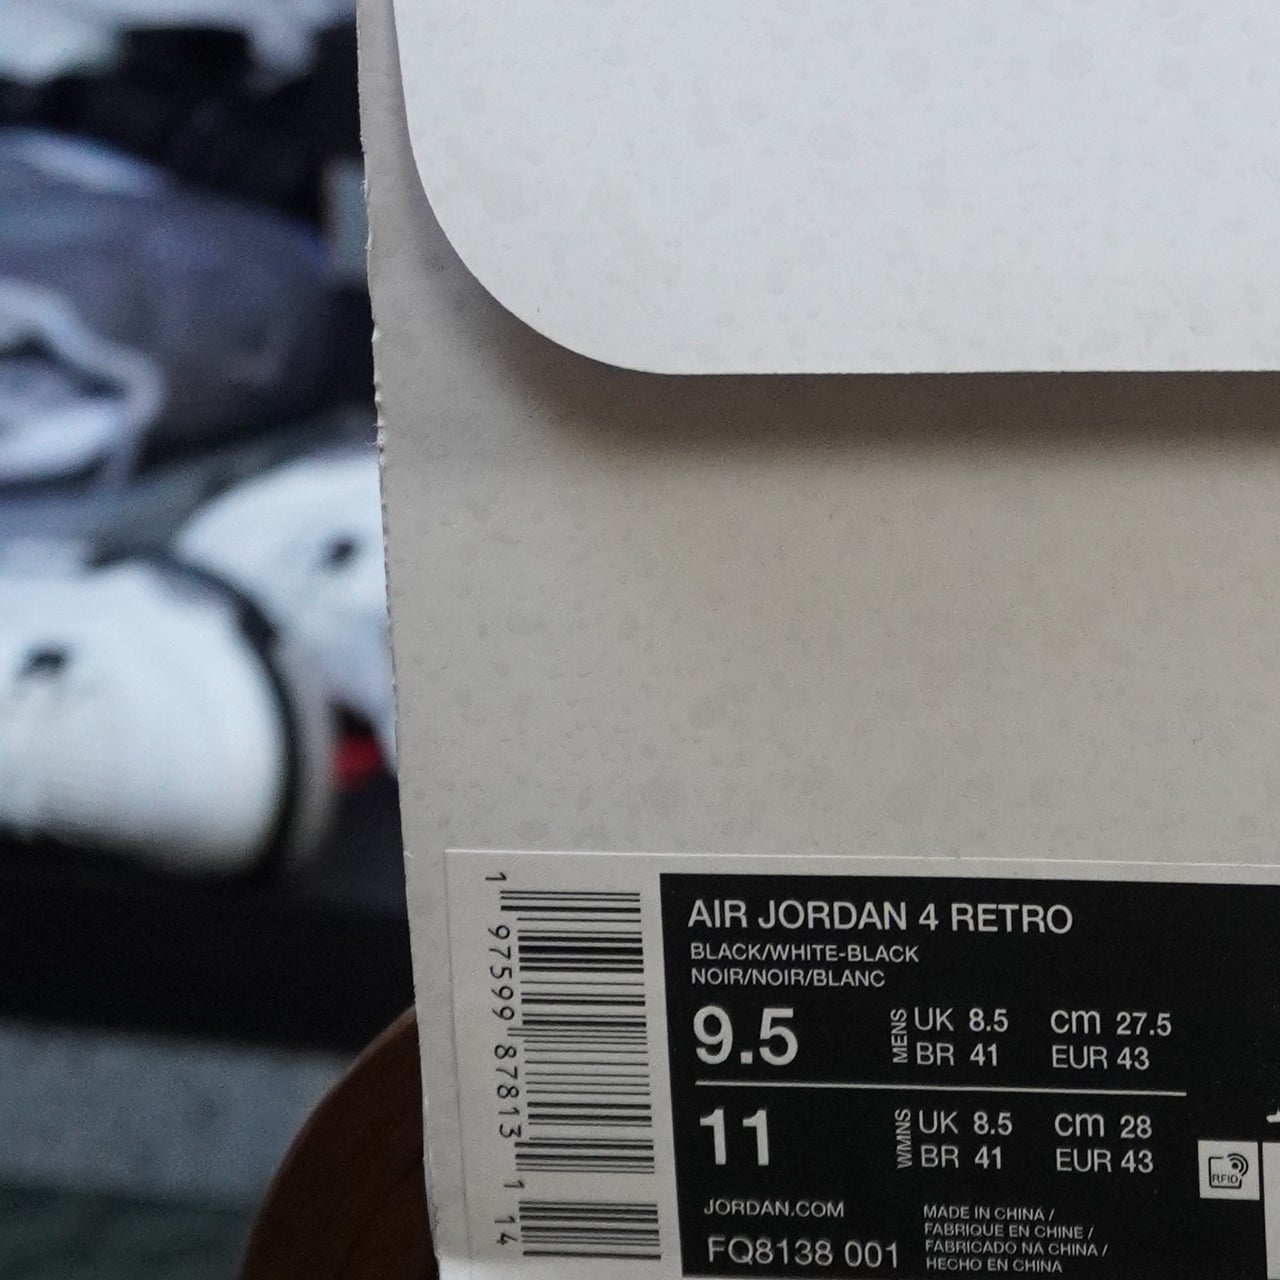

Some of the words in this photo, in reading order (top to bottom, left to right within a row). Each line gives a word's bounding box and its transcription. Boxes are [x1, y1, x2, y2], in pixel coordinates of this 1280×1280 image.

[485, 872, 507, 881] 1
[688, 899, 747, 927] AIR
[758, 900, 906, 930] JORDAN
[919, 903, 939, 930] 4
[952, 903, 1072, 934] RETRO
[691, 942, 919, 962] BLACK/WHITE-BLACK
[488, 925, 515, 1020] 97599
[692, 968, 885, 987] NOIR/NOIR/BLANC
[694, 1005, 798, 1065] 9.5
[890, 1009, 908, 1062] MENS
[915, 1007, 953, 1031] UK
[969, 1008, 1008, 1032] 8.5
[1051, 1010, 1100, 1034] cm
[1117, 1012, 1171, 1036] 27.5
[917, 1042, 954, 1065] BR
[970, 1043, 997, 1066] 41
[1052, 1045, 1107, 1069] EUR
[1117, 1047, 1149, 1070] 43
[494, 1045, 521, 1138] 87813
[700, 1109, 769, 1165] 11
[919, 1110, 958, 1133] UK
[974, 1112, 1012, 1135] 8.5
[1055, 1113, 1104, 1137] cm
[1121, 1115, 1152, 1138] 28
[895, 1109, 912, 1168] WMNS
[921, 1145, 959, 1168] BR
[975, 1146, 1001, 1169] 41
[1056, 1149, 1111, 1172] EUR
[1121, 1150, 1153, 1173] 43
[504, 1180, 525, 1188] 1
[1212, 1174, 1238, 1184] RFID
[704, 1199, 844, 1217] JORDAN.COM
[924, 1205, 969, 1219] MADE
[975, 1206, 990, 1219] IN
[995, 1208, 1044, 1220] CHINA
[495, 1216, 518, 1245] 14
[925, 1222, 1003, 1236] FABRIQUE
[1009, 1225, 1029, 1237] EN
[1035, 1226, 1083, 1239] CHINE
[708, 1236, 833, 1265] FQ8138
[845, 1241, 897, 1268] 001
[926, 1240, 1016, 1253] FABRICADO
[1022, 1242, 1044, 1255] NA
[1048, 1243, 1097, 1256] CHINA
[927, 1257, 982, 1271] HECHO
[988, 1257, 1008, 1271] EN
[1013, 1259, 1062, 1272] CHINA
